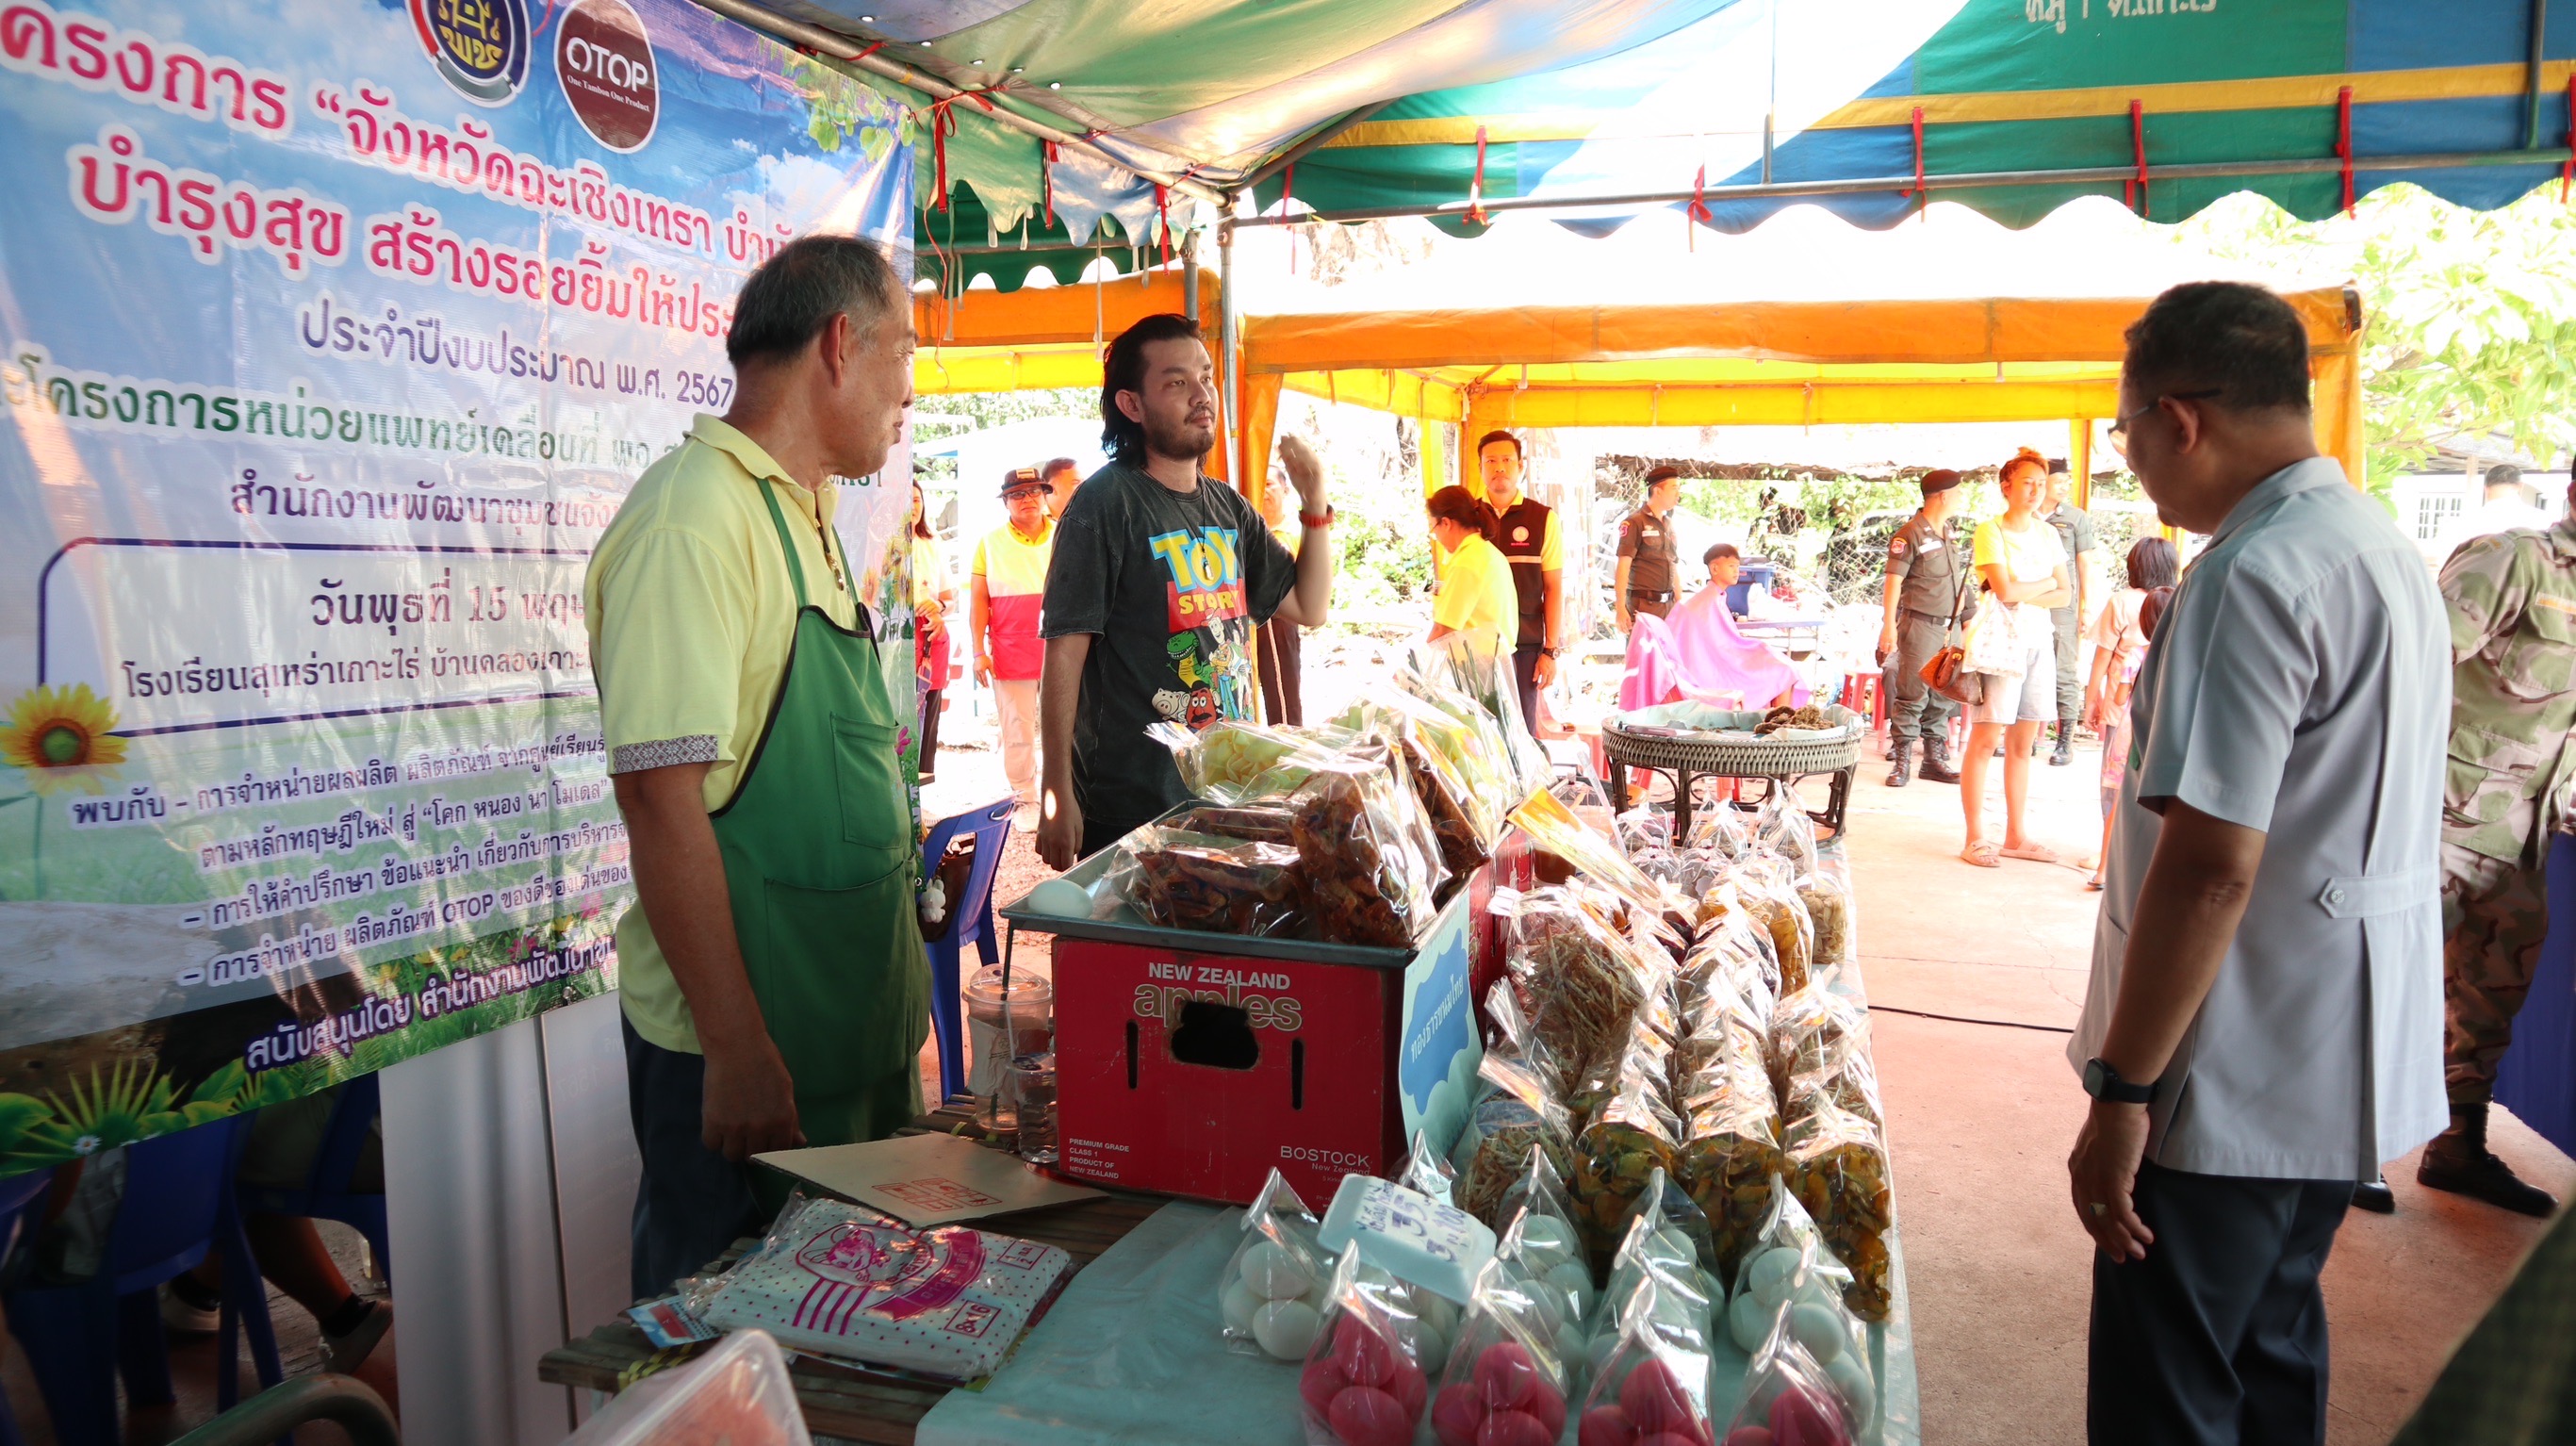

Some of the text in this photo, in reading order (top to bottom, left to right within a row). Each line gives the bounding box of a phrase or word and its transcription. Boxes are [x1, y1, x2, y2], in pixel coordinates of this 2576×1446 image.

[566, 37, 648, 93] OTOP
[566, 74, 650, 113] One Tambon One Product
[78, 135, 344, 271] บำรุงสุข
[303, 298, 734, 408] ประจำปีงบประมาณ พ.ศ. 2567
[231, 468, 616, 535] สำนักงานพัฒนาชุมชนจัง
[1150, 527, 1238, 592] TOY
[310, 567, 451, 636] วันพุธที่
[468, 585, 507, 622] 15
[1177, 590, 1239, 615] STORY
[121, 646, 420, 698] โรงเรียนสุเหร่าเกาะไร่
[72, 786, 166, 825] พบกับ
[197, 758, 398, 811] การจำหน่ายผลผลิต
[406, 744, 493, 781] ผลิตภัณฑ์
[201, 779, 608, 867] ตามหลักทฤษฎีใหม่ สู่ “โคก หนอง นา โมเดล”
[213, 869, 373, 926] การให้คำปรึกษา
[381, 846, 469, 888] ข้อแนะนำ
[212, 928, 336, 982] การจำหน่าย
[344, 900, 436, 946] ผลิตภัณฑ์
[442, 893, 494, 923] OTOP
[1148, 961, 1291, 990] NEW ZEALAND
[247, 995, 411, 1068] สนับสนุนโดย
[1069, 1138, 1130, 1152] PREMIUM GRADE
[1069, 1147, 1092, 1157] CLASS
[1069, 1156, 1104, 1167] PRODUCT
[1069, 1165, 1120, 1179] NEW ZEALAND
[1280, 1145, 1370, 1168] BOSTOCK
[1311, 1162, 1370, 1176] New Zealand
